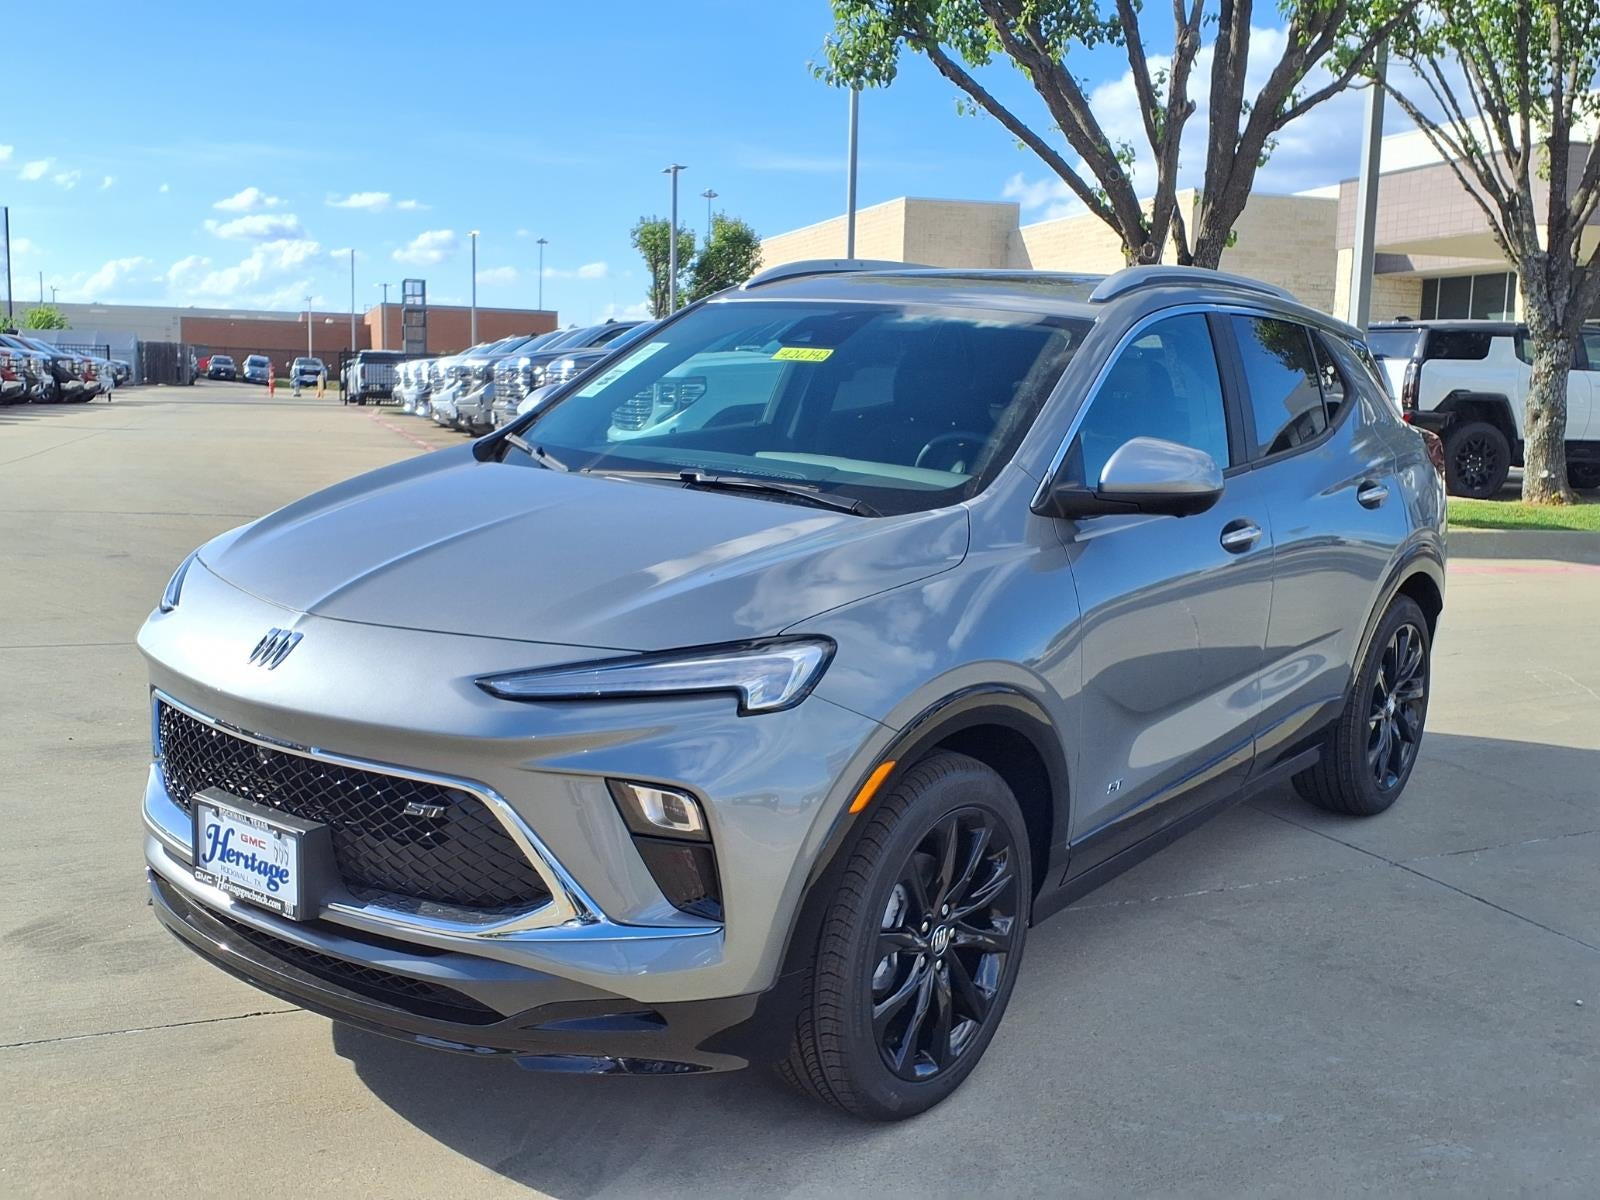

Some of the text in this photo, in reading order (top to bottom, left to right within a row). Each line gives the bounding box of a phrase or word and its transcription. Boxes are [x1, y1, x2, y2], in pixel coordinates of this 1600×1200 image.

[240, 833, 267, 850] GMC
[202, 823, 290, 892] Heritage
[194, 870, 213, 884] GMC
